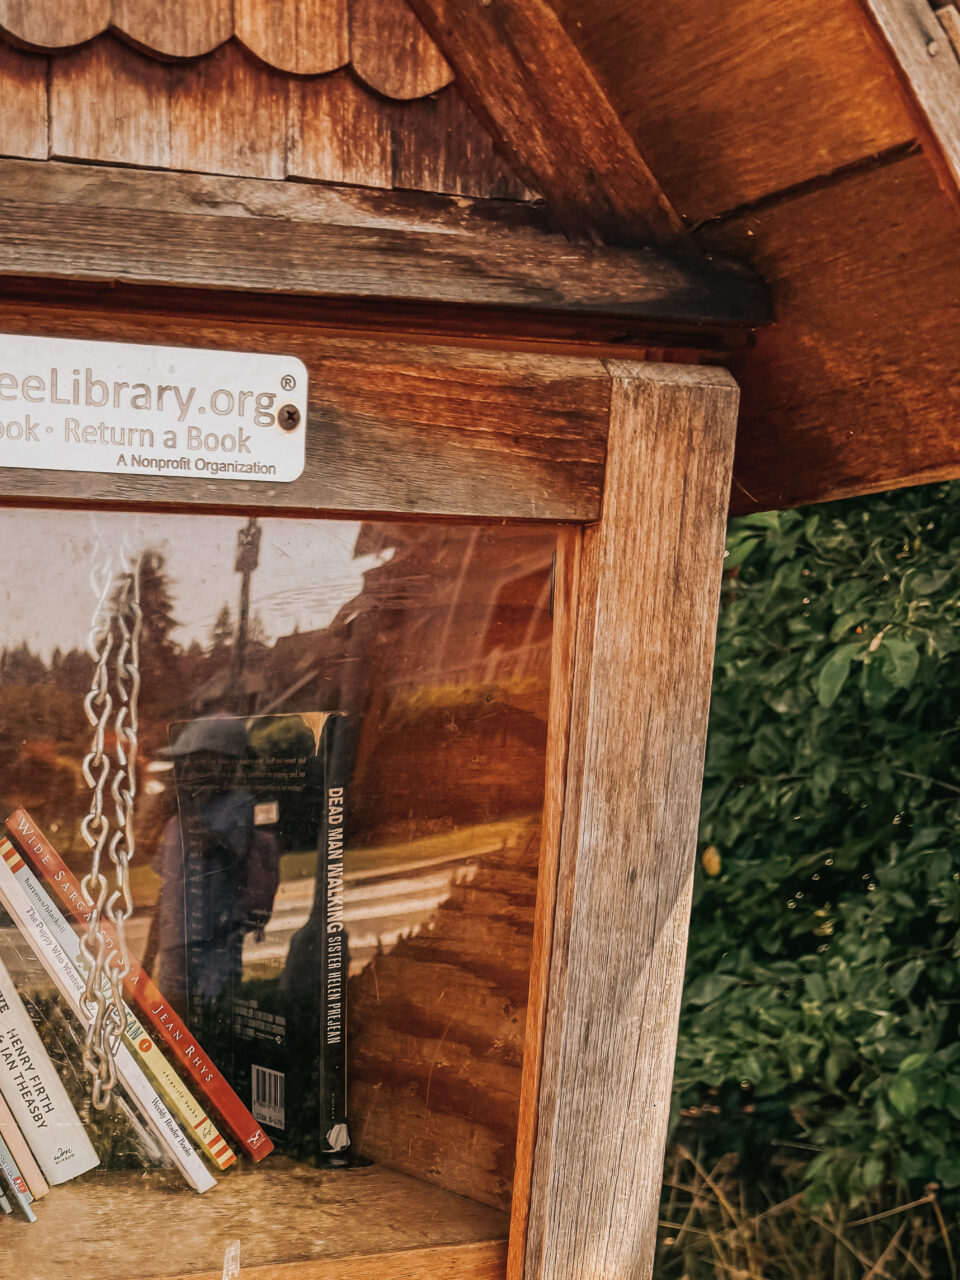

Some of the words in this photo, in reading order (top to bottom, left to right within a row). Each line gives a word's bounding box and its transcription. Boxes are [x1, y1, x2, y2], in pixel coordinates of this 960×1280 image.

[65, 417, 154, 448] Return
[164, 431, 178, 449] a
[188, 425, 250, 454] Book
[117, 455, 127, 467] A
[130, 455, 191, 471] Nonprofit
[194, 459, 276, 476] Organization
[327, 787, 343, 824] DEAD
[15, 818, 52, 864] WIDE
[327, 827, 343, 859] MAN
[22, 878, 67, 932] barrows/blackall
[25, 906, 40, 923] The
[325, 862, 343, 933] WALKING
[32, 922, 54, 947] Puppy
[327, 936, 341, 968] SISTER
[49, 945, 66, 964] Who
[60, 962, 83, 991] Wanted
[327, 971, 341, 1000] HELEN
[326, 1002, 340, 1043] PREJEAN
[151, 1003, 185, 1041] JEAN
[182, 1044, 216, 1082] RHYS
[0, 1046, 18, 1071] IAN
[10, 1073, 49, 1130] THEASBY
[4, 1027, 36, 1073] HENRY
[27, 1074, 56, 1113] FIRTH
[161, 1070, 185, 1098] chronicle
[149, 1097, 169, 1119] Weekly
[162, 1117, 181, 1139] Reader
[176, 1137, 193, 1157] Books
